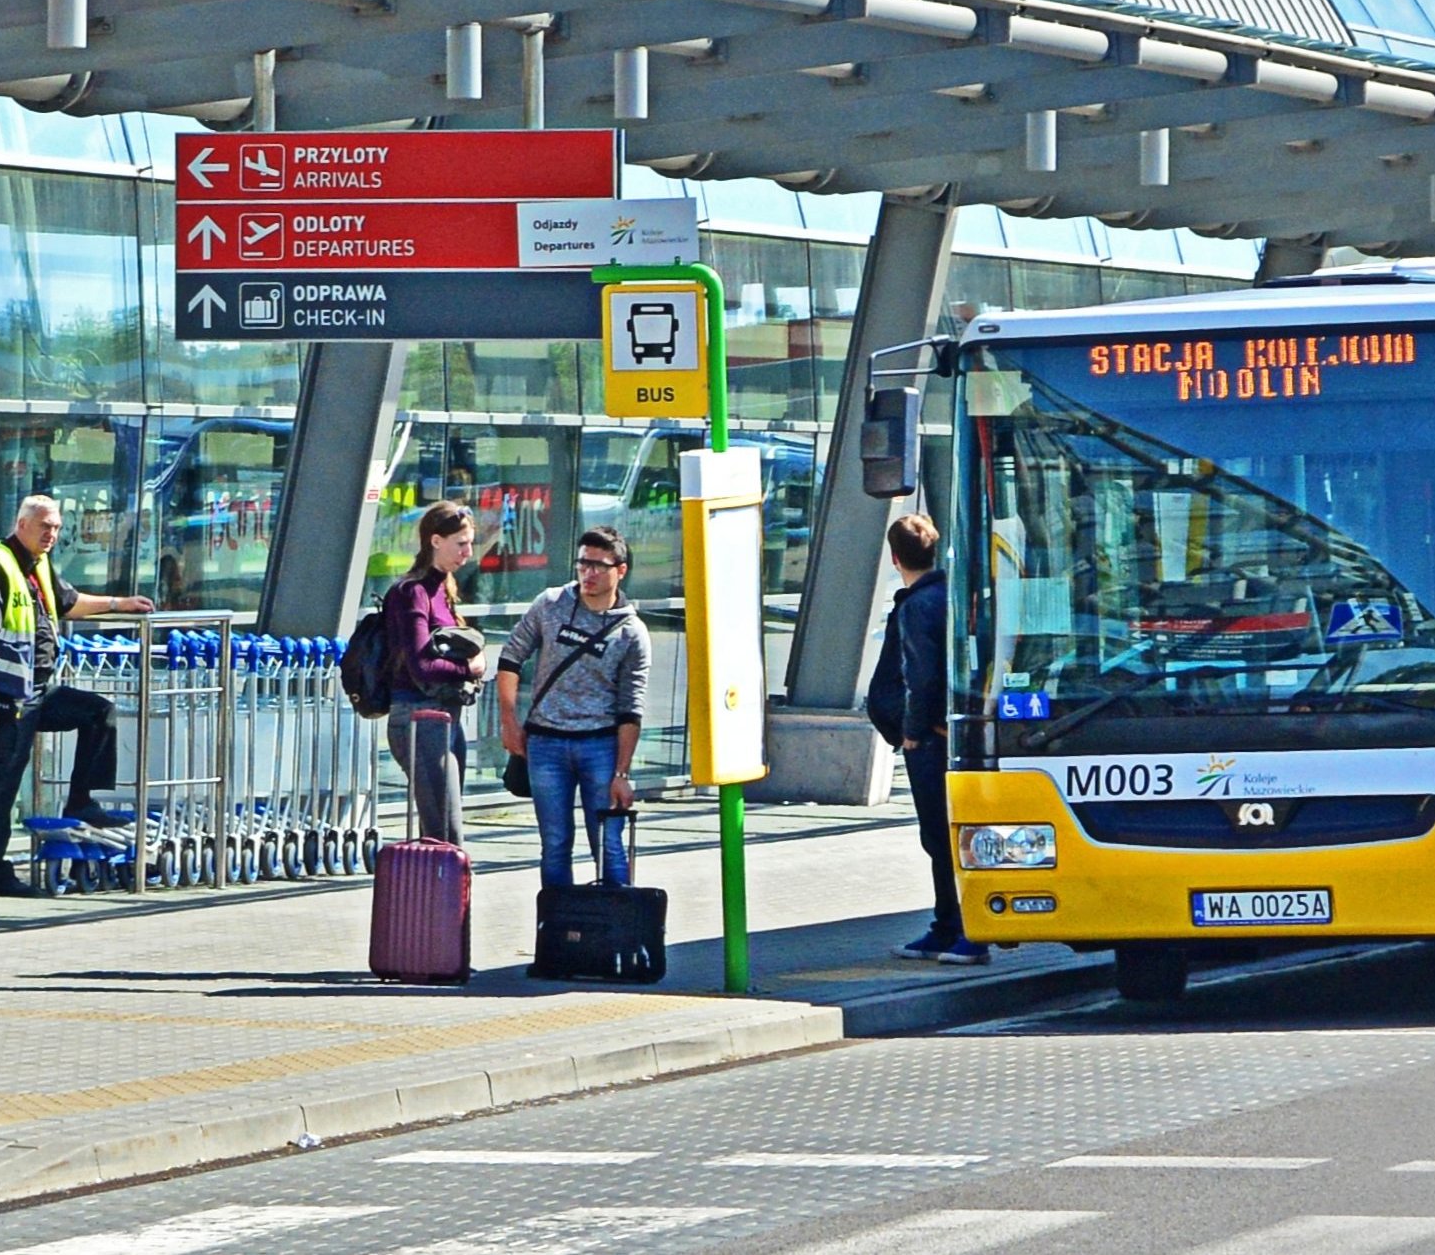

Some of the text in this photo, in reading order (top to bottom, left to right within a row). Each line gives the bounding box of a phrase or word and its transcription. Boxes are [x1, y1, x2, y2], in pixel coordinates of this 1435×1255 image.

[293, 146, 387, 163] PRZYLOTY
[293, 170, 381, 187] ARRIVALS
[293, 214, 364, 231] ODLOTY
[533, 219, 578, 230] Odjazdy
[293, 239, 414, 255] DEPARTURES
[533, 240, 595, 252] Departures
[293, 284, 386, 301] ODPRAWA
[293, 308, 384, 325] CHECK-IN
[1089, 341, 1212, 373] STACJA
[635, 385, 674, 402] BUS
[497, 497, 546, 555] AVIS
[1065, 762, 1172, 797] M003
[1243, 773, 1277, 784] Koleje
[1243, 784, 1315, 794] Mazowieckie
[1208, 893, 1324, 916] WA 0025A
